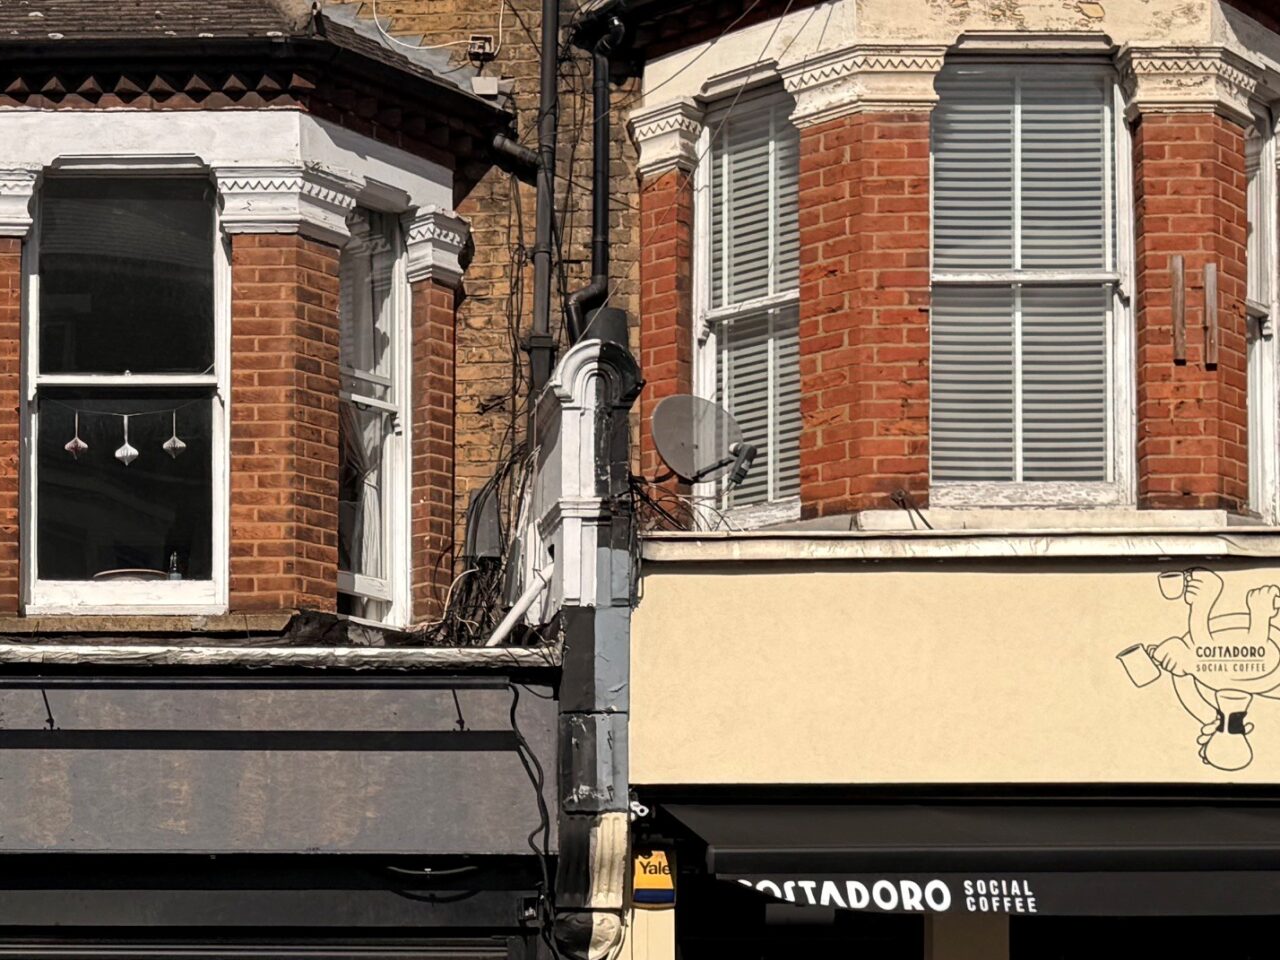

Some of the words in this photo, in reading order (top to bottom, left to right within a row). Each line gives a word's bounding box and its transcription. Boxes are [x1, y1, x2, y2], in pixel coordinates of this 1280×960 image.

[1195, 645, 1266, 658] COSTADORO
[1195, 663, 1229, 673] SOCIAL
[1232, 663, 1266, 673] COFFEE
[639, 861, 671, 875] Yale
[963, 879, 1033, 896] SOCIAL
[737, 879, 952, 912] OSTADORO
[966, 896, 1038, 913] COFFEE
